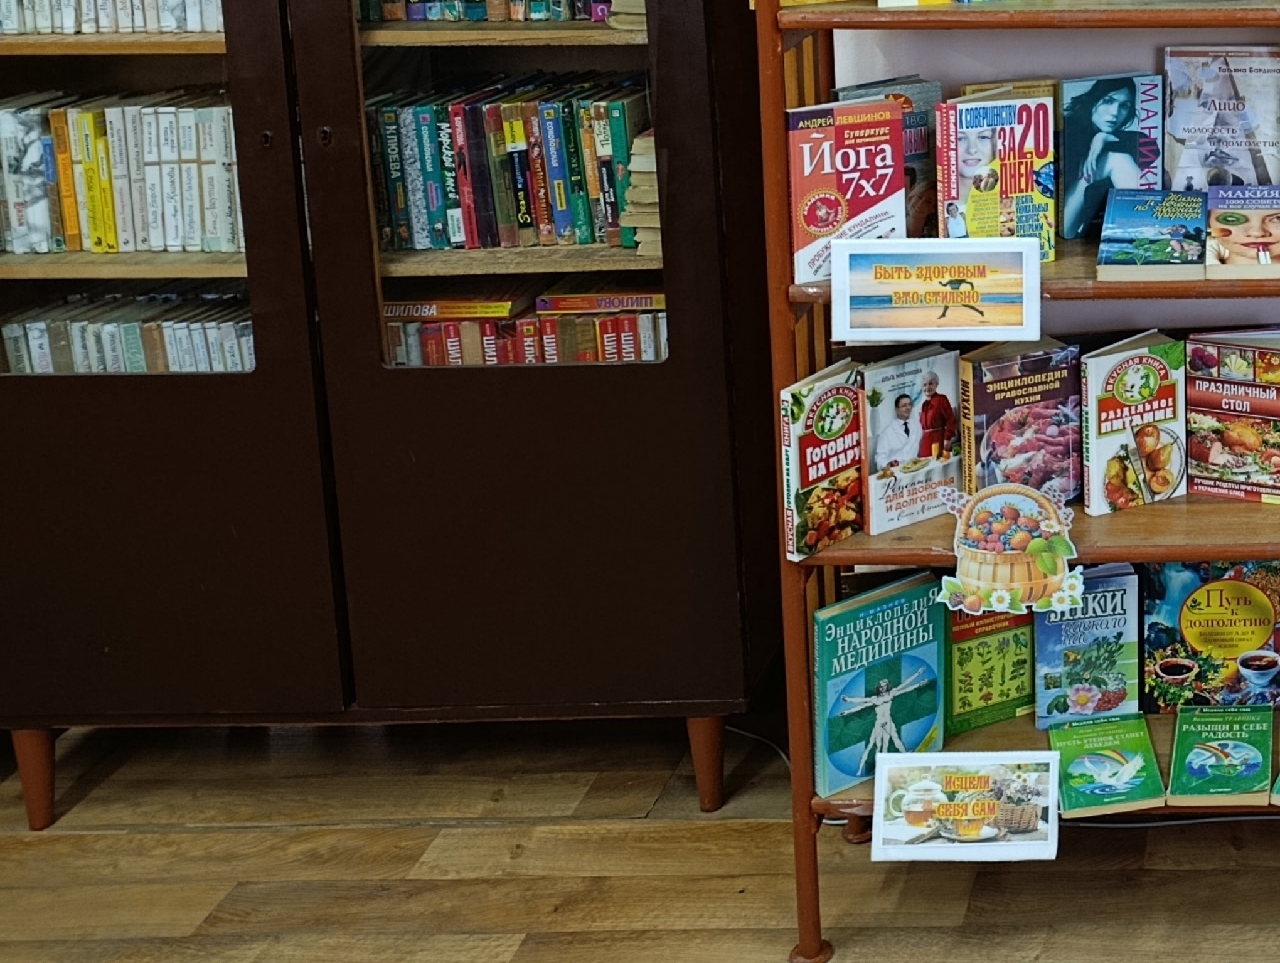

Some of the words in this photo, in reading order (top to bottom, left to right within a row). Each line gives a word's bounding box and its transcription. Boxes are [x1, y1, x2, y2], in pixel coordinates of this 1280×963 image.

[1218, 66, 1248, 74] Татьяна
[1207, 98, 1246, 113] Лицо
[797, 116, 834, 129] АНДРЕЙ
[835, 110, 892, 126] ЛЕВШИНОВ
[948, 110, 958, 148] КАПРИЗ
[843, 125, 891, 139] Суперкурс
[1017, 101, 1050, 160] 20
[799, 131, 895, 178] Йога
[948, 150, 958, 199] ЖЕНСКИЙ
[1000, 151, 1035, 199] ДНЕЙ
[873, 264, 912, 280] БЫТЬ
[915, 265, 986, 282] ЗДОРОВЫМ
[595, 295, 654, 309] ШИЛОВА
[893, 290, 920, 305] ЭТО
[923, 290, 980, 305] СТИЛЬНО
[383, 304, 438, 317] ШИЛОВА
[986, 369, 1068, 393] ЭНЦИКЛОПЕДИЯ
[994, 380, 1061, 400] ПРАВОСЛАВНОЙ
[1195, 379, 1278, 400] ПРАЗДНИЧНЫЙ
[1014, 395, 1041, 406] КУХНИ
[1100, 397, 1174, 421] РАЗДЕЛЬНОЕ
[1221, 397, 1251, 413] СТОЛ
[786, 508, 795, 554] ВКУСНАЯ
[836, 608, 929, 657] НАРОДНОЙ
[830, 623, 934, 677] МЕДИЦИНЫ
[944, 774, 991, 791] ИСЦЕЛИ
[936, 802, 969, 818] СЕБЯ
[972, 801, 998, 817] САМ
